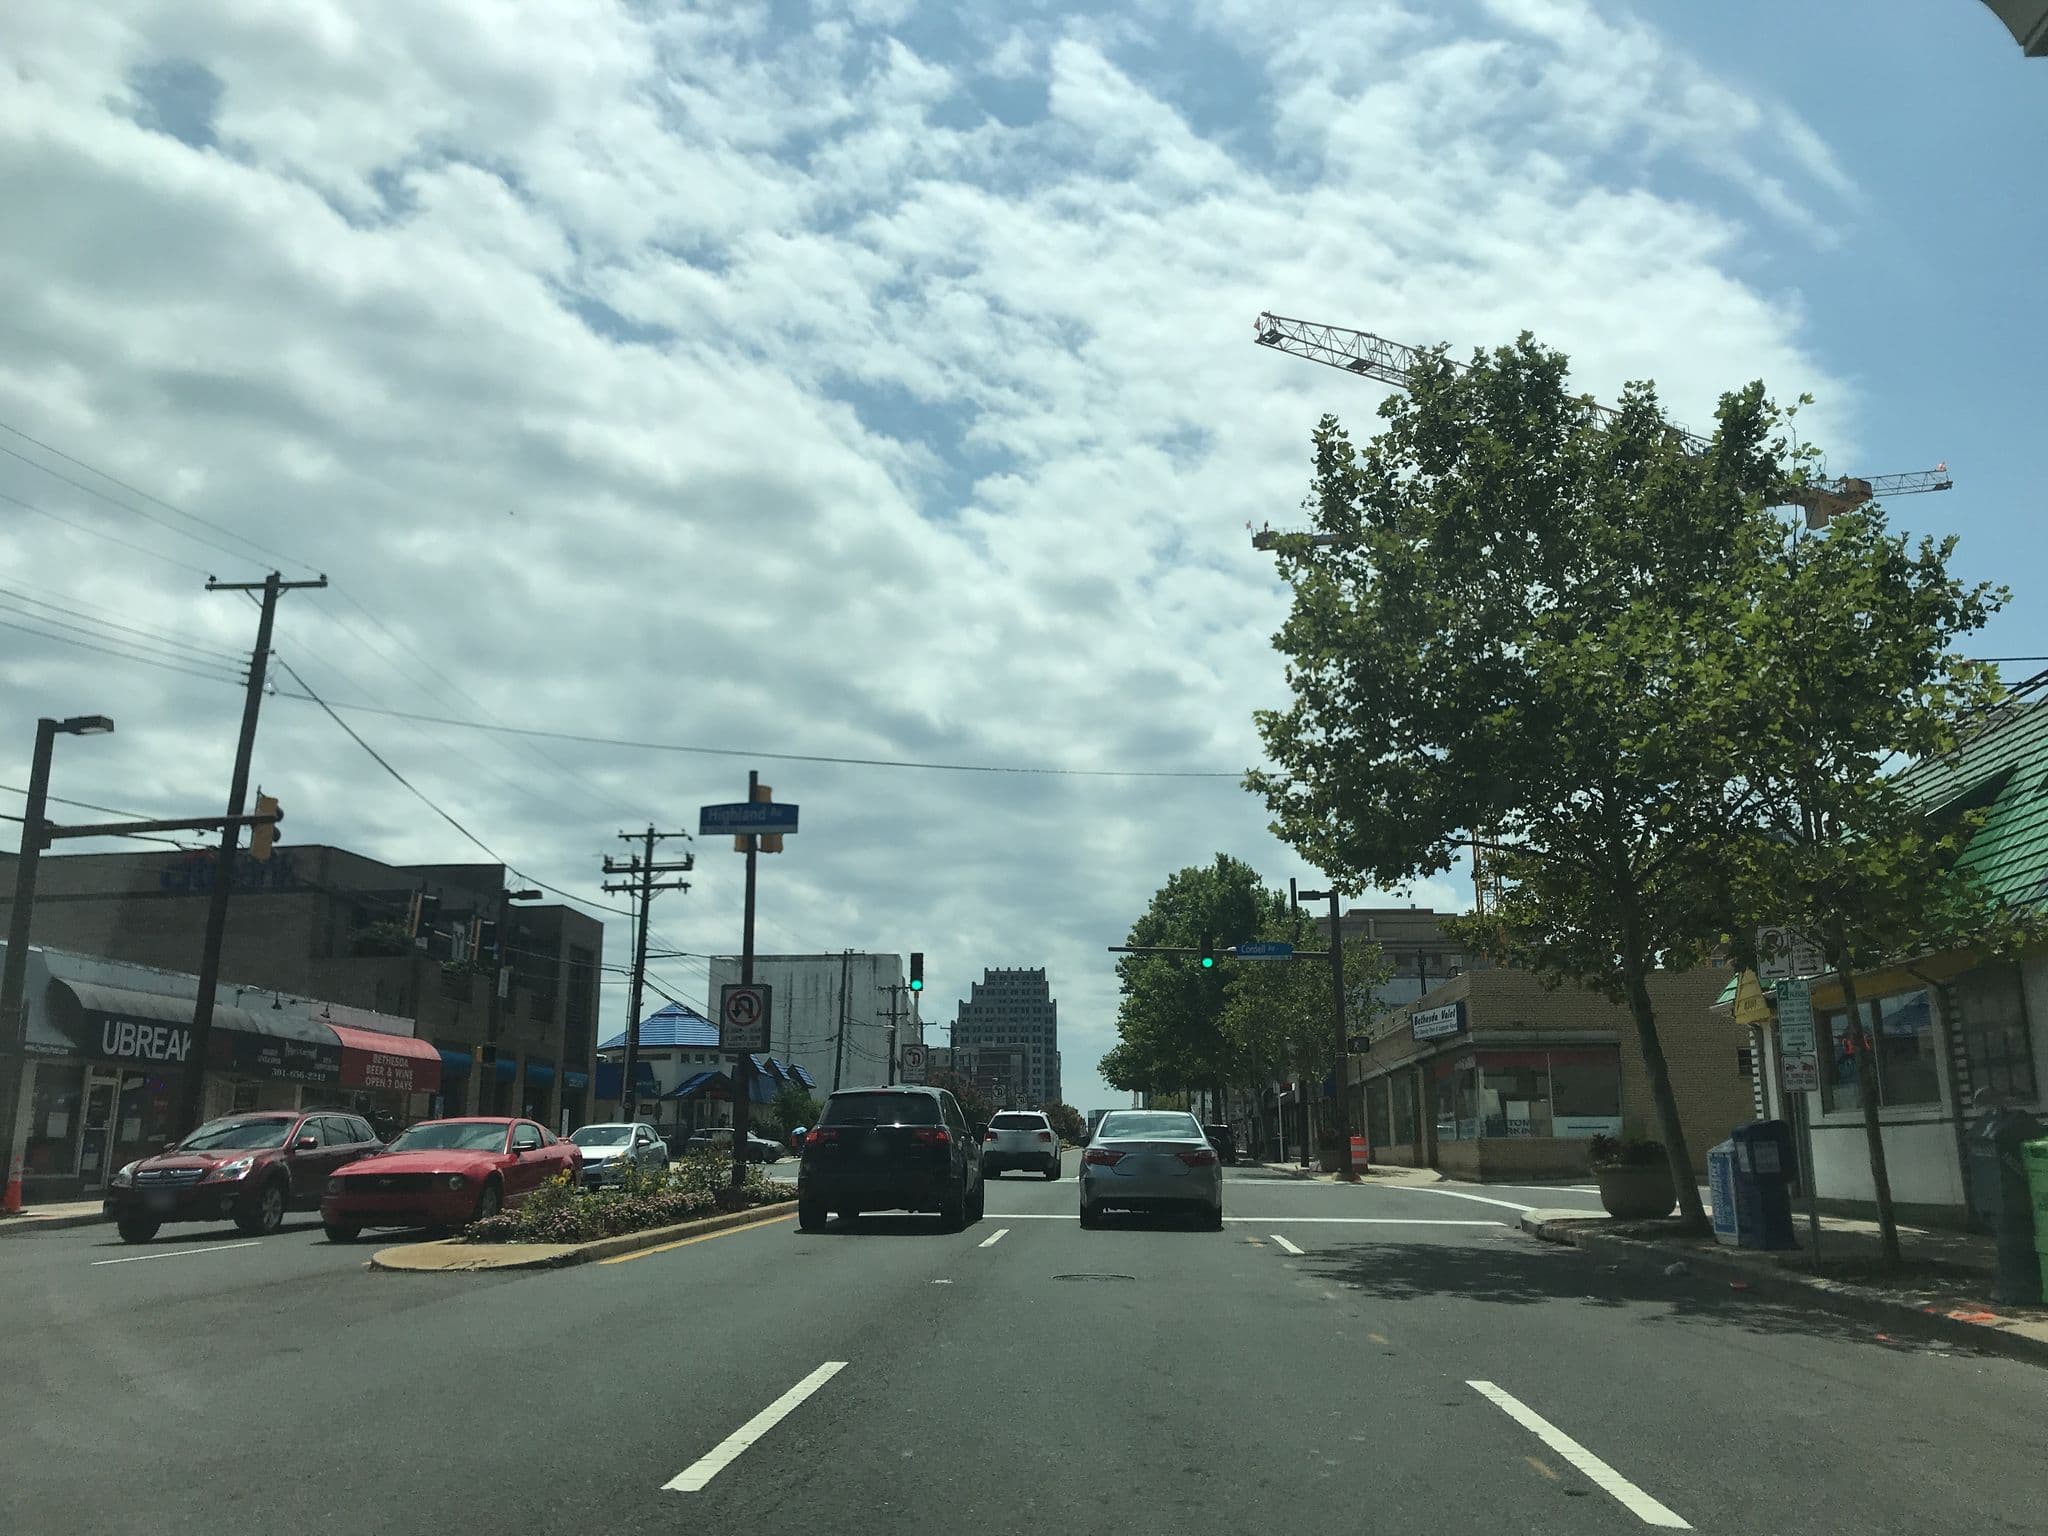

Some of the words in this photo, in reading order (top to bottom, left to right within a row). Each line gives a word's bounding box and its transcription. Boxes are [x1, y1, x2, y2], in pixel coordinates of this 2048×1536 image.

[1241, 943, 1266, 953] Cordell
[1414, 1012, 1438, 1025] Bethesda
[1441, 1008, 1456, 1020] Valet
[373, 1054, 409, 1067] BETHESDA
[366, 1065, 384, 1076] BEER
[387, 1068, 393, 1077] &
[395, 1068, 413, 1080] WINE
[365, 1077, 386, 1088] OPEN
[394, 1080, 413, 1091] DAYS
